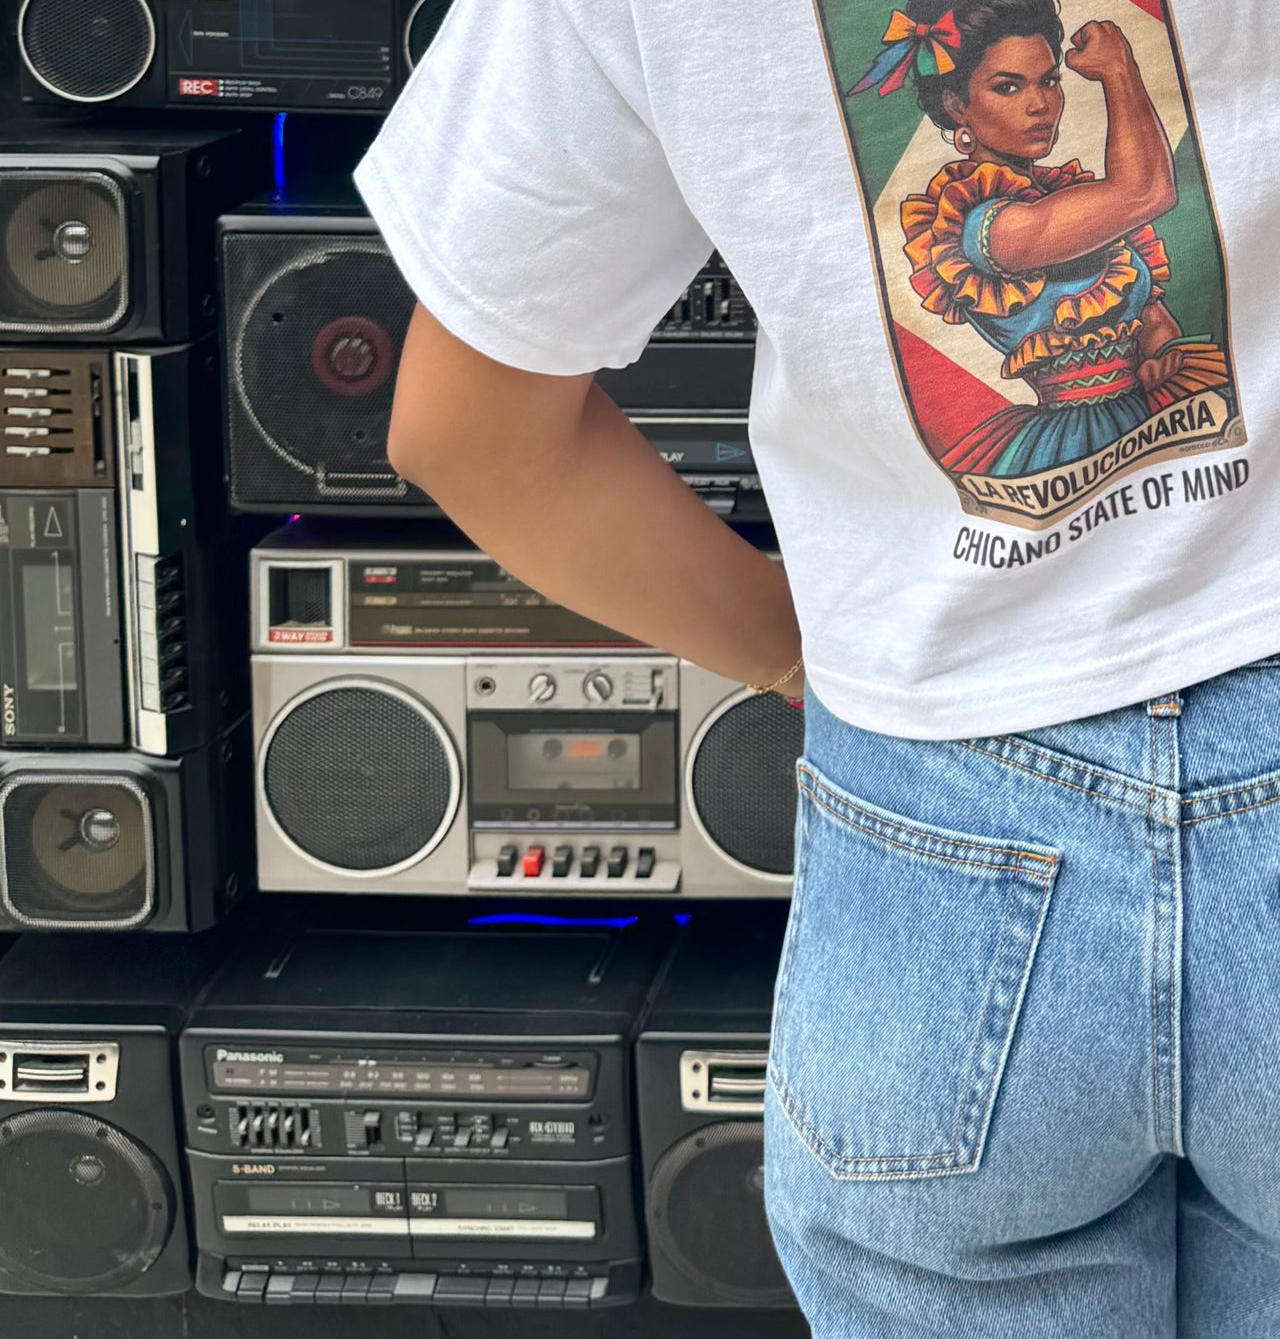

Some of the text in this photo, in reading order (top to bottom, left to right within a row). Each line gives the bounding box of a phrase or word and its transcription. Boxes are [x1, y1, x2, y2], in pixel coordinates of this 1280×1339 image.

[183, 80, 215, 94] REC
[348, 86, 383, 101] C849
[967, 478, 1002, 501] LA
[953, 458, 1250, 569] CHICANO STATE OF MIND
[4, 683, 15, 736] SONY
[216, 1049, 283, 1062] Panasonic
[232, 1165, 275, 1174] 5-BAND
